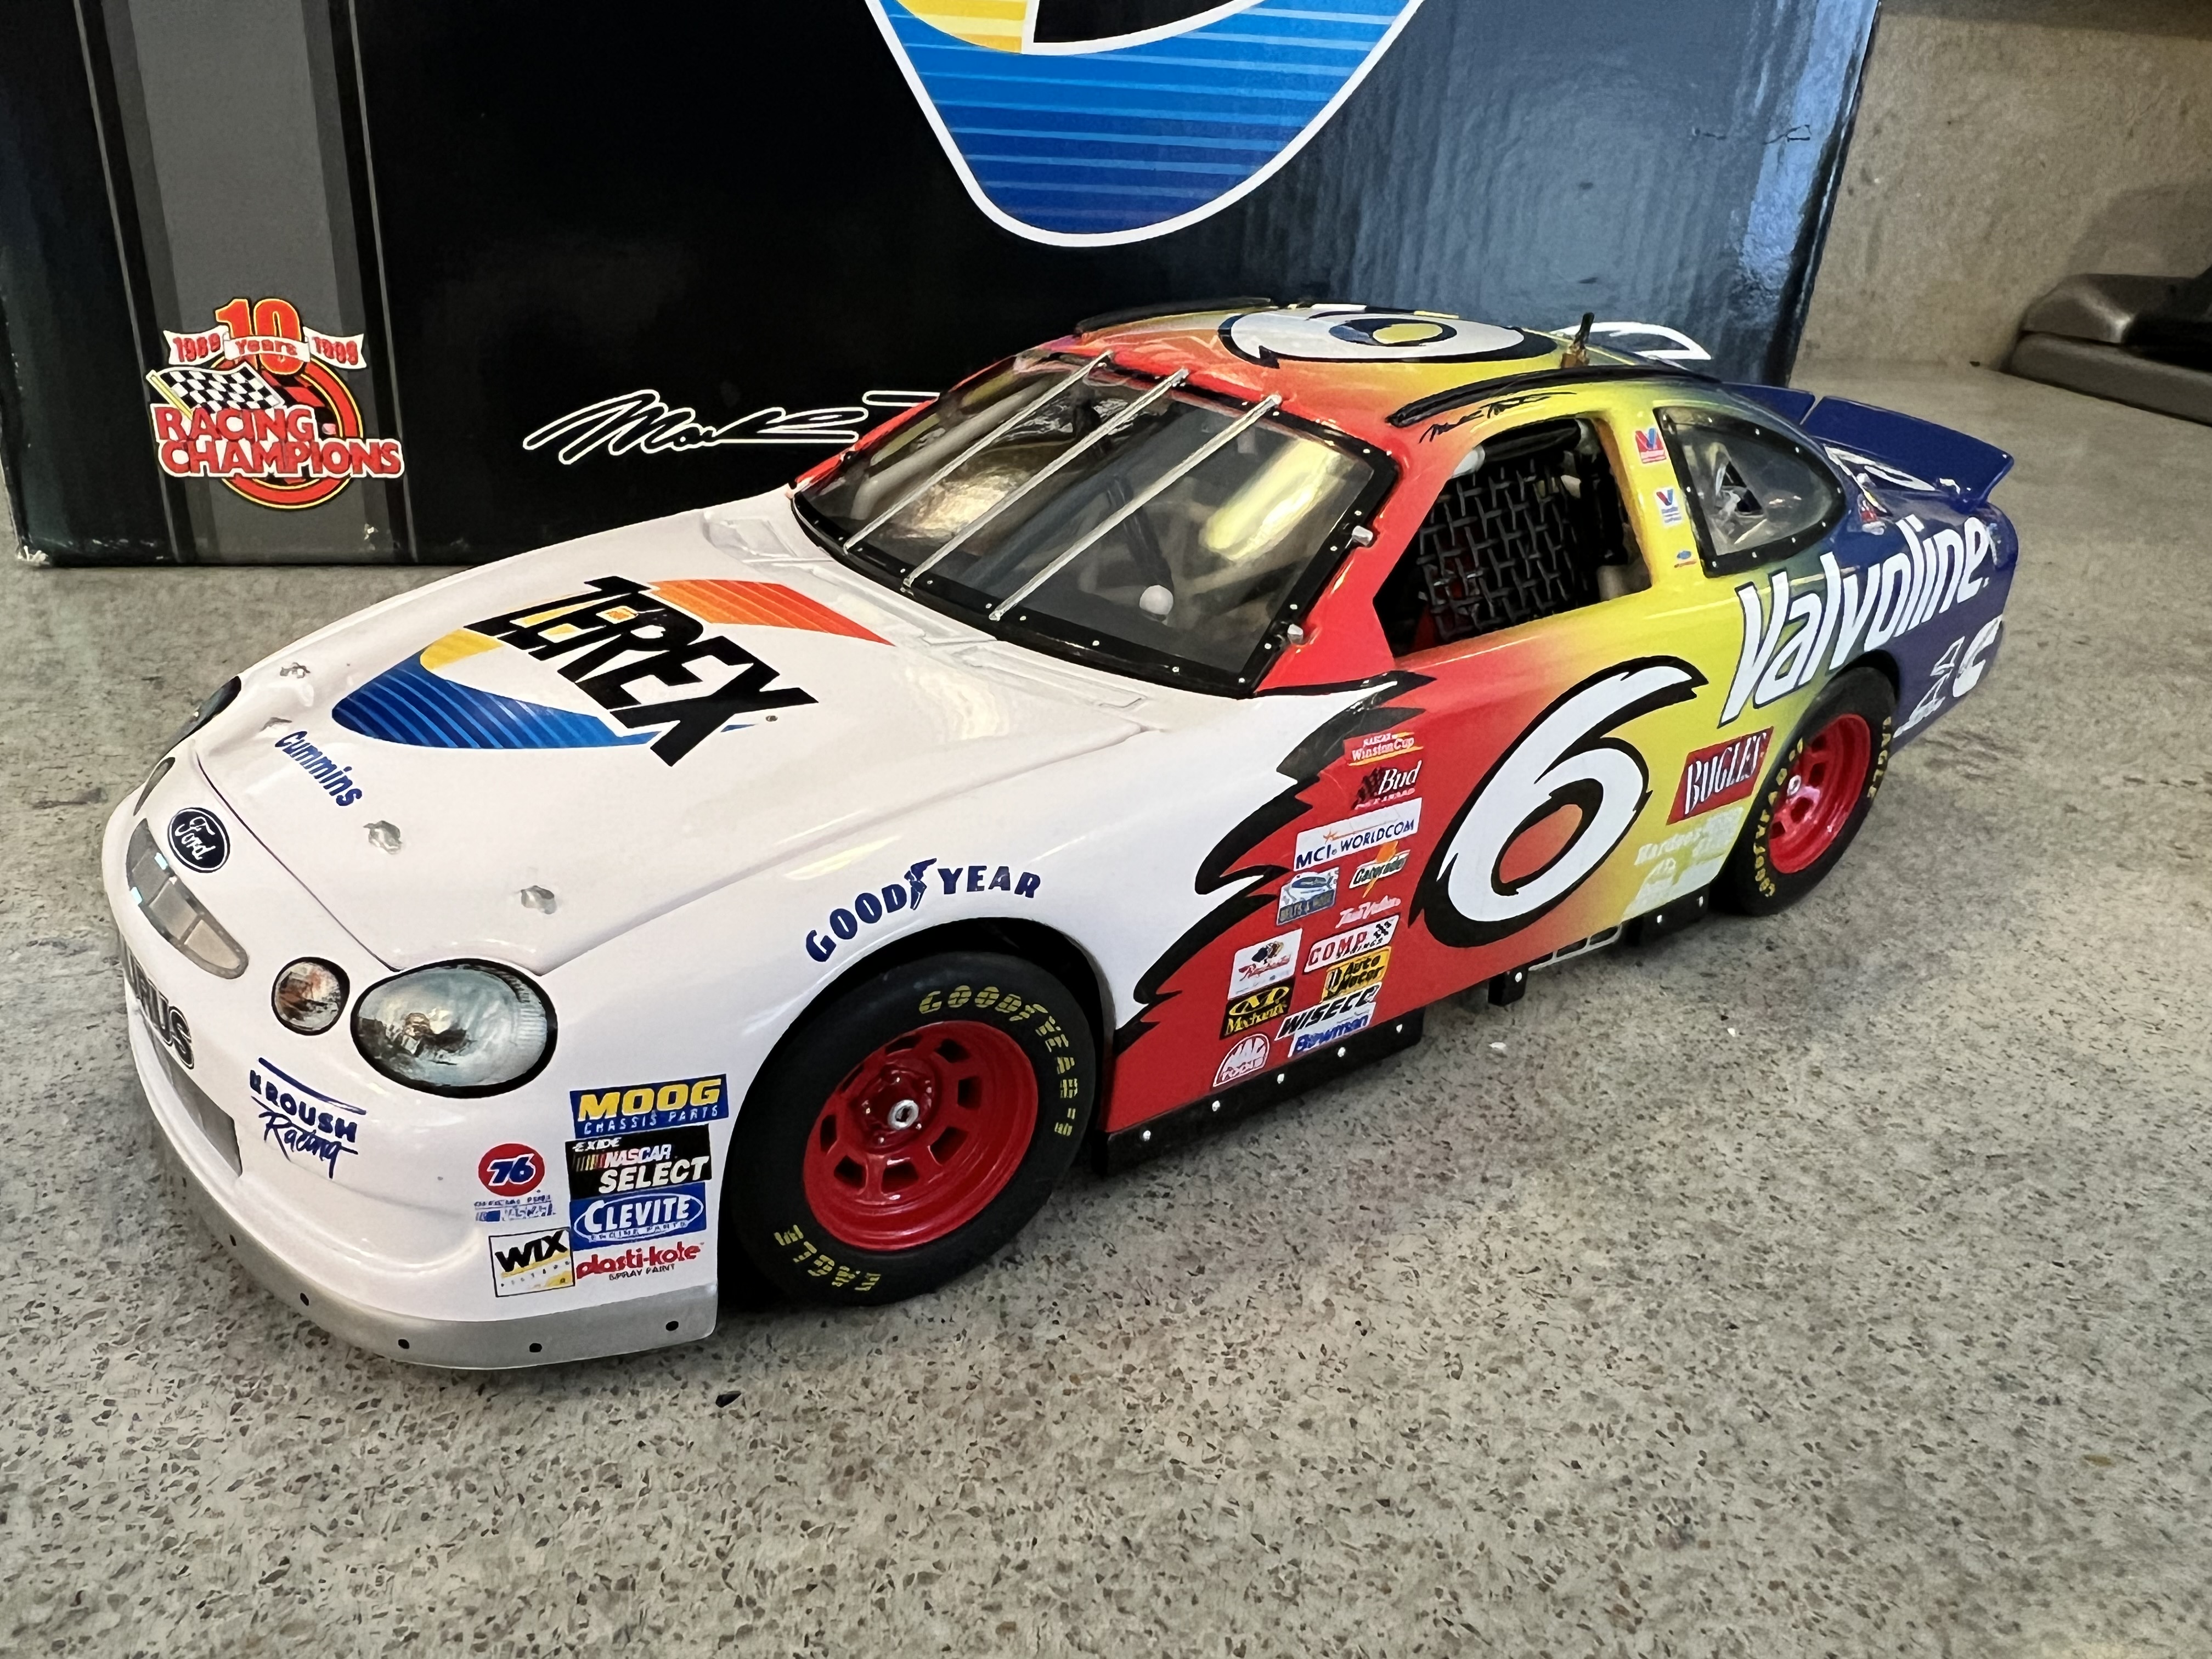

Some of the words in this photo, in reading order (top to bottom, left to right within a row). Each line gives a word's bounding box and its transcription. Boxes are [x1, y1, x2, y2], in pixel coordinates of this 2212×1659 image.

[154, 408, 314, 438] RACING
[161, 439, 402, 474] CHAMPIONS
[1718, 515, 1990, 728] Valvoline
[464, 575, 819, 767] ZEREX
[275, 731, 363, 807] Cummins
[1378, 760, 1422, 795] Bud
[1421, 656, 1709, 939] 6
[175, 816, 216, 861] Ford
[1295, 844, 1331, 870] MCI
[1341, 819, 1414, 852] WORLDCOM
[1308, 931, 1368, 966] COMP
[266, 1081, 358, 1143] ROUSH
[578, 1079, 721, 1122] MOOG
[584, 1110, 658, 1135] CHASSIS
[668, 1104, 718, 1122] PARTS
[257, 1108, 359, 1180] Racing
[573, 1137, 622, 1152] EXIDE
[604, 1144, 672, 1169] NASCAR
[487, 1153, 535, 1187] 76
[599, 1155, 710, 1194] SELECT
[584, 1195, 690, 1234] CLEVITE
[495, 1229, 568, 1272] WIX
[576, 1242, 701, 1280] plasti-kote
[646, 1263, 675, 1274] PAINT
[774, 1224, 881, 1291] EAGLE
